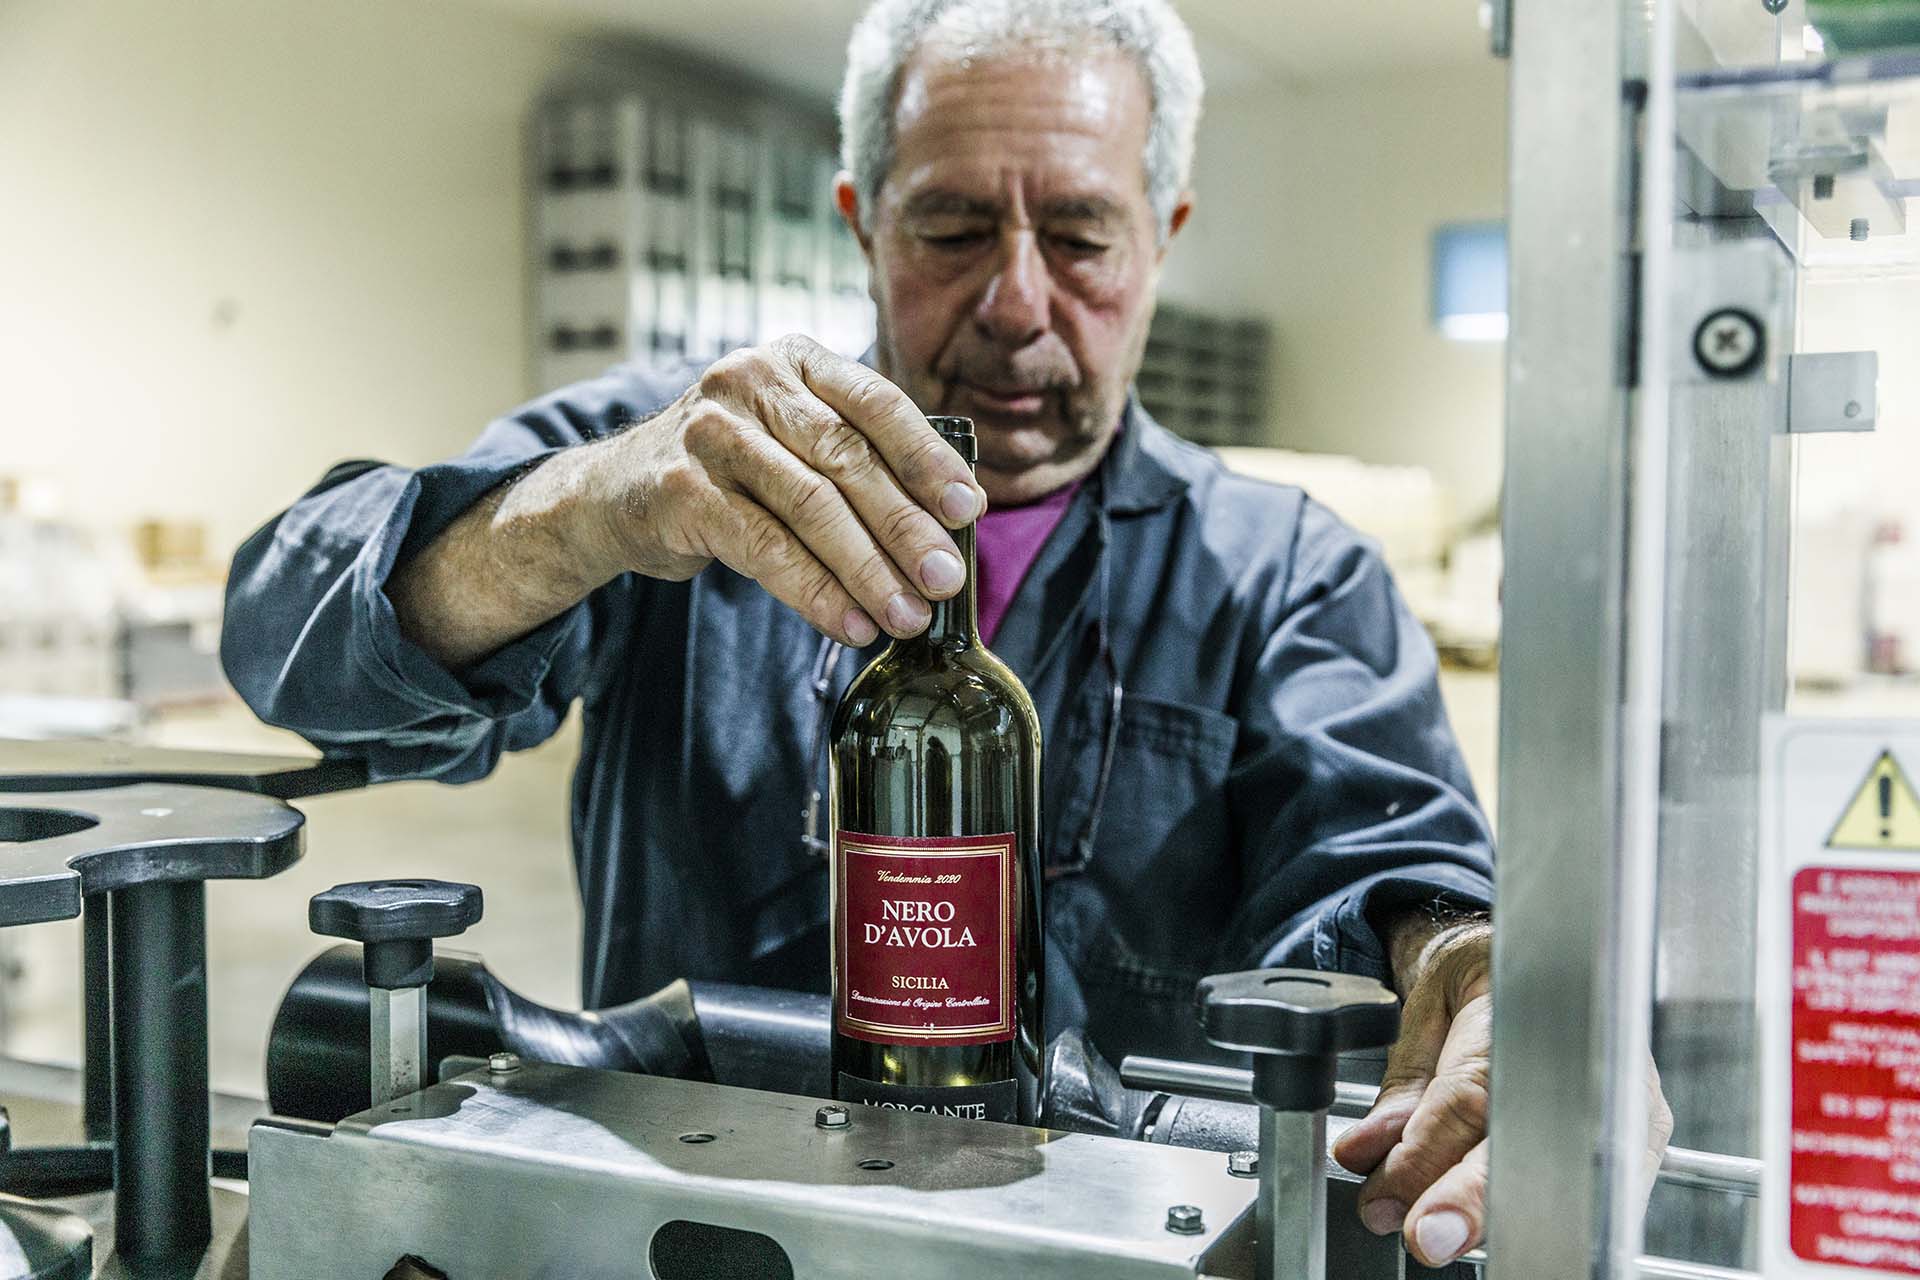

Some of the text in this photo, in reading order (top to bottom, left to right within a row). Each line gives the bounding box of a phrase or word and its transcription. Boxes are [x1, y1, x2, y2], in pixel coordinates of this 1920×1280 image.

[877, 869, 962, 884] Vendemmia 2020
[881, 899, 955, 922] NERO
[863, 922, 977, 948] D'AVOLA
[891, 975, 949, 990] SICILIA
[901, 998, 912, 1007] di
[913, 997, 942, 1010] Origine
[945, 995, 990, 1007] Controllata
